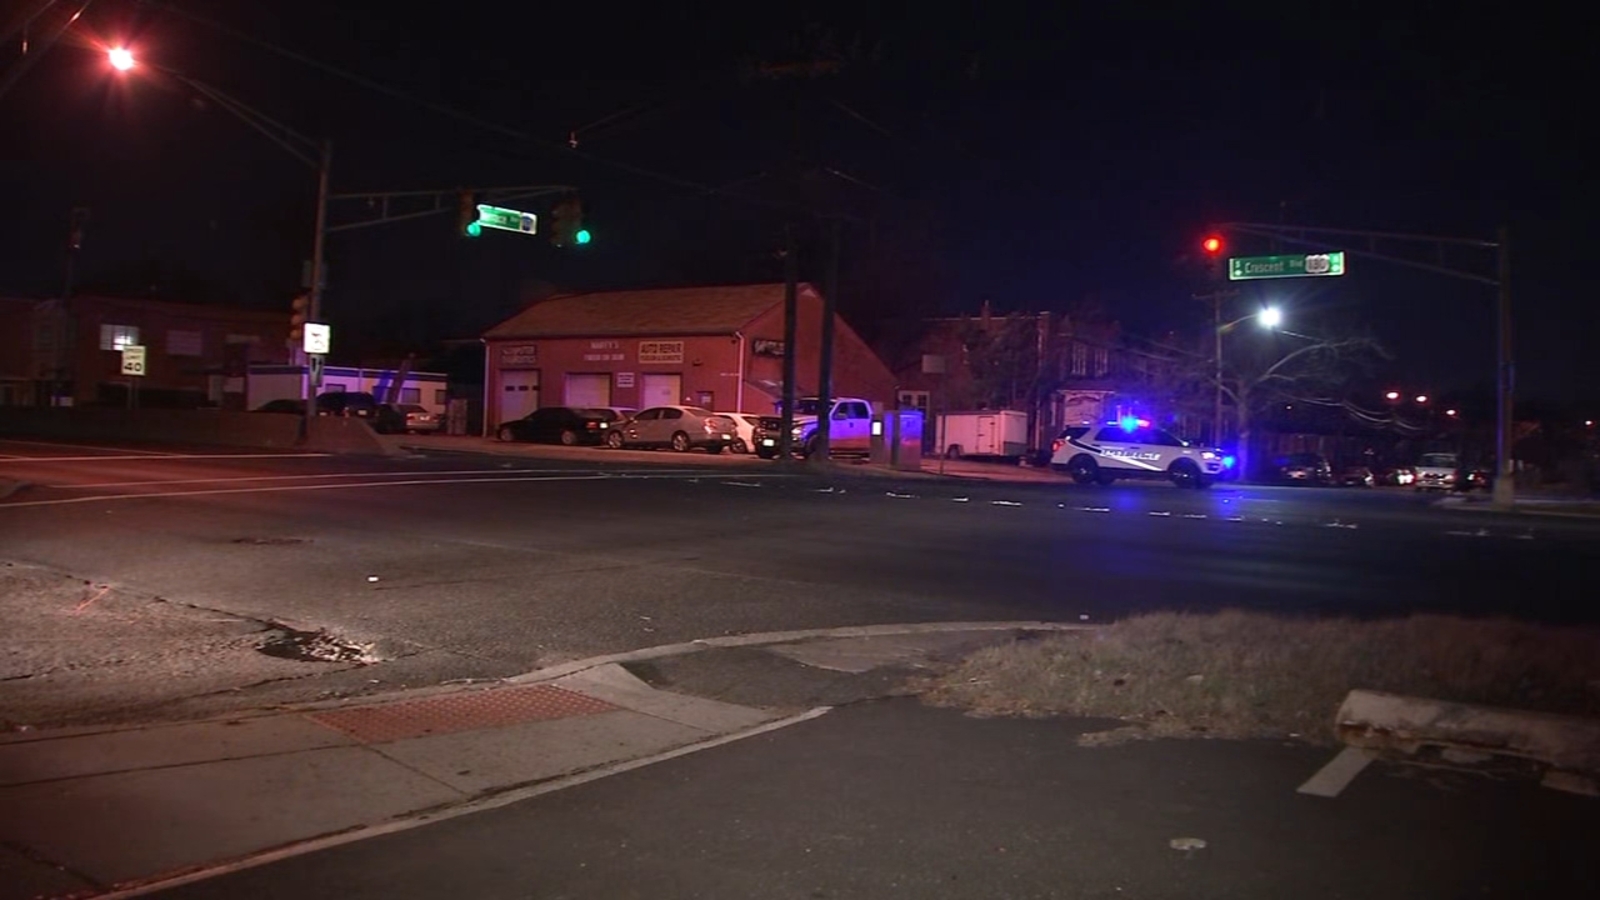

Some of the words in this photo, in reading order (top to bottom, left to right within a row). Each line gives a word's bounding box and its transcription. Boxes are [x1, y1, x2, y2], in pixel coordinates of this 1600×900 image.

[1244, 261, 1284, 274] Crescent
[640, 342, 658, 354] AUTO
[659, 342, 682, 354] REPAIR
[124, 362, 142, 372] 40
